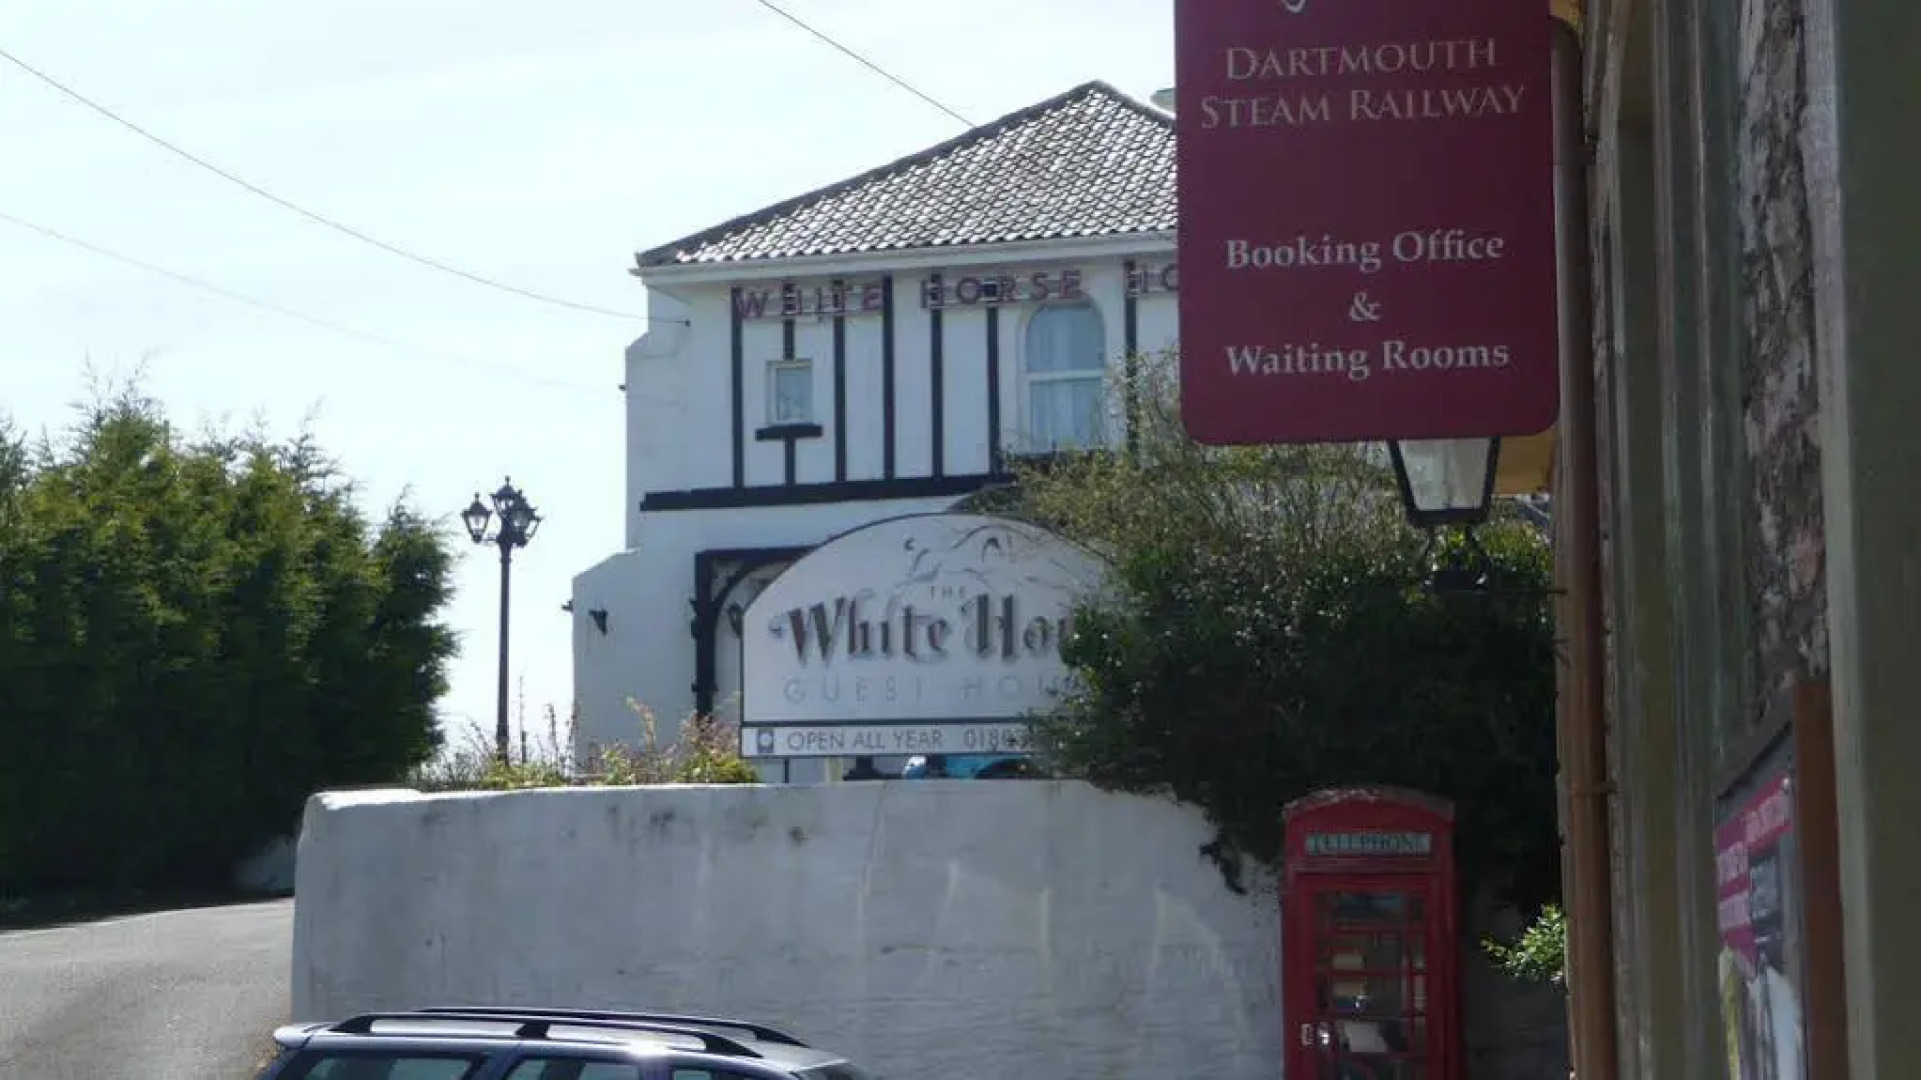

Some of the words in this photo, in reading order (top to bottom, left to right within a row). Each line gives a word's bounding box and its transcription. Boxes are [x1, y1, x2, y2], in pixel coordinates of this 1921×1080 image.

[1226, 39, 1496, 80] DARTMOUTH
[1201, 93, 1331, 129] STEAM
[1350, 83, 1525, 121] RAILWAY
[1227, 234, 1381, 273] Booking
[1392, 229, 1505, 263] Office
[733, 286, 885, 320] WHITE
[921, 269, 1083, 309] HORSE
[1349, 292, 1381, 322] &
[1226, 343, 1370, 381] Waiting
[1382, 340, 1510, 371] Rooms
[930, 585, 967, 601] THE
[770, 596, 952, 666] White
[787, 730, 844, 751] OPEN
[852, 729, 887, 749] ALL
[893, 728, 943, 748] YEAR
